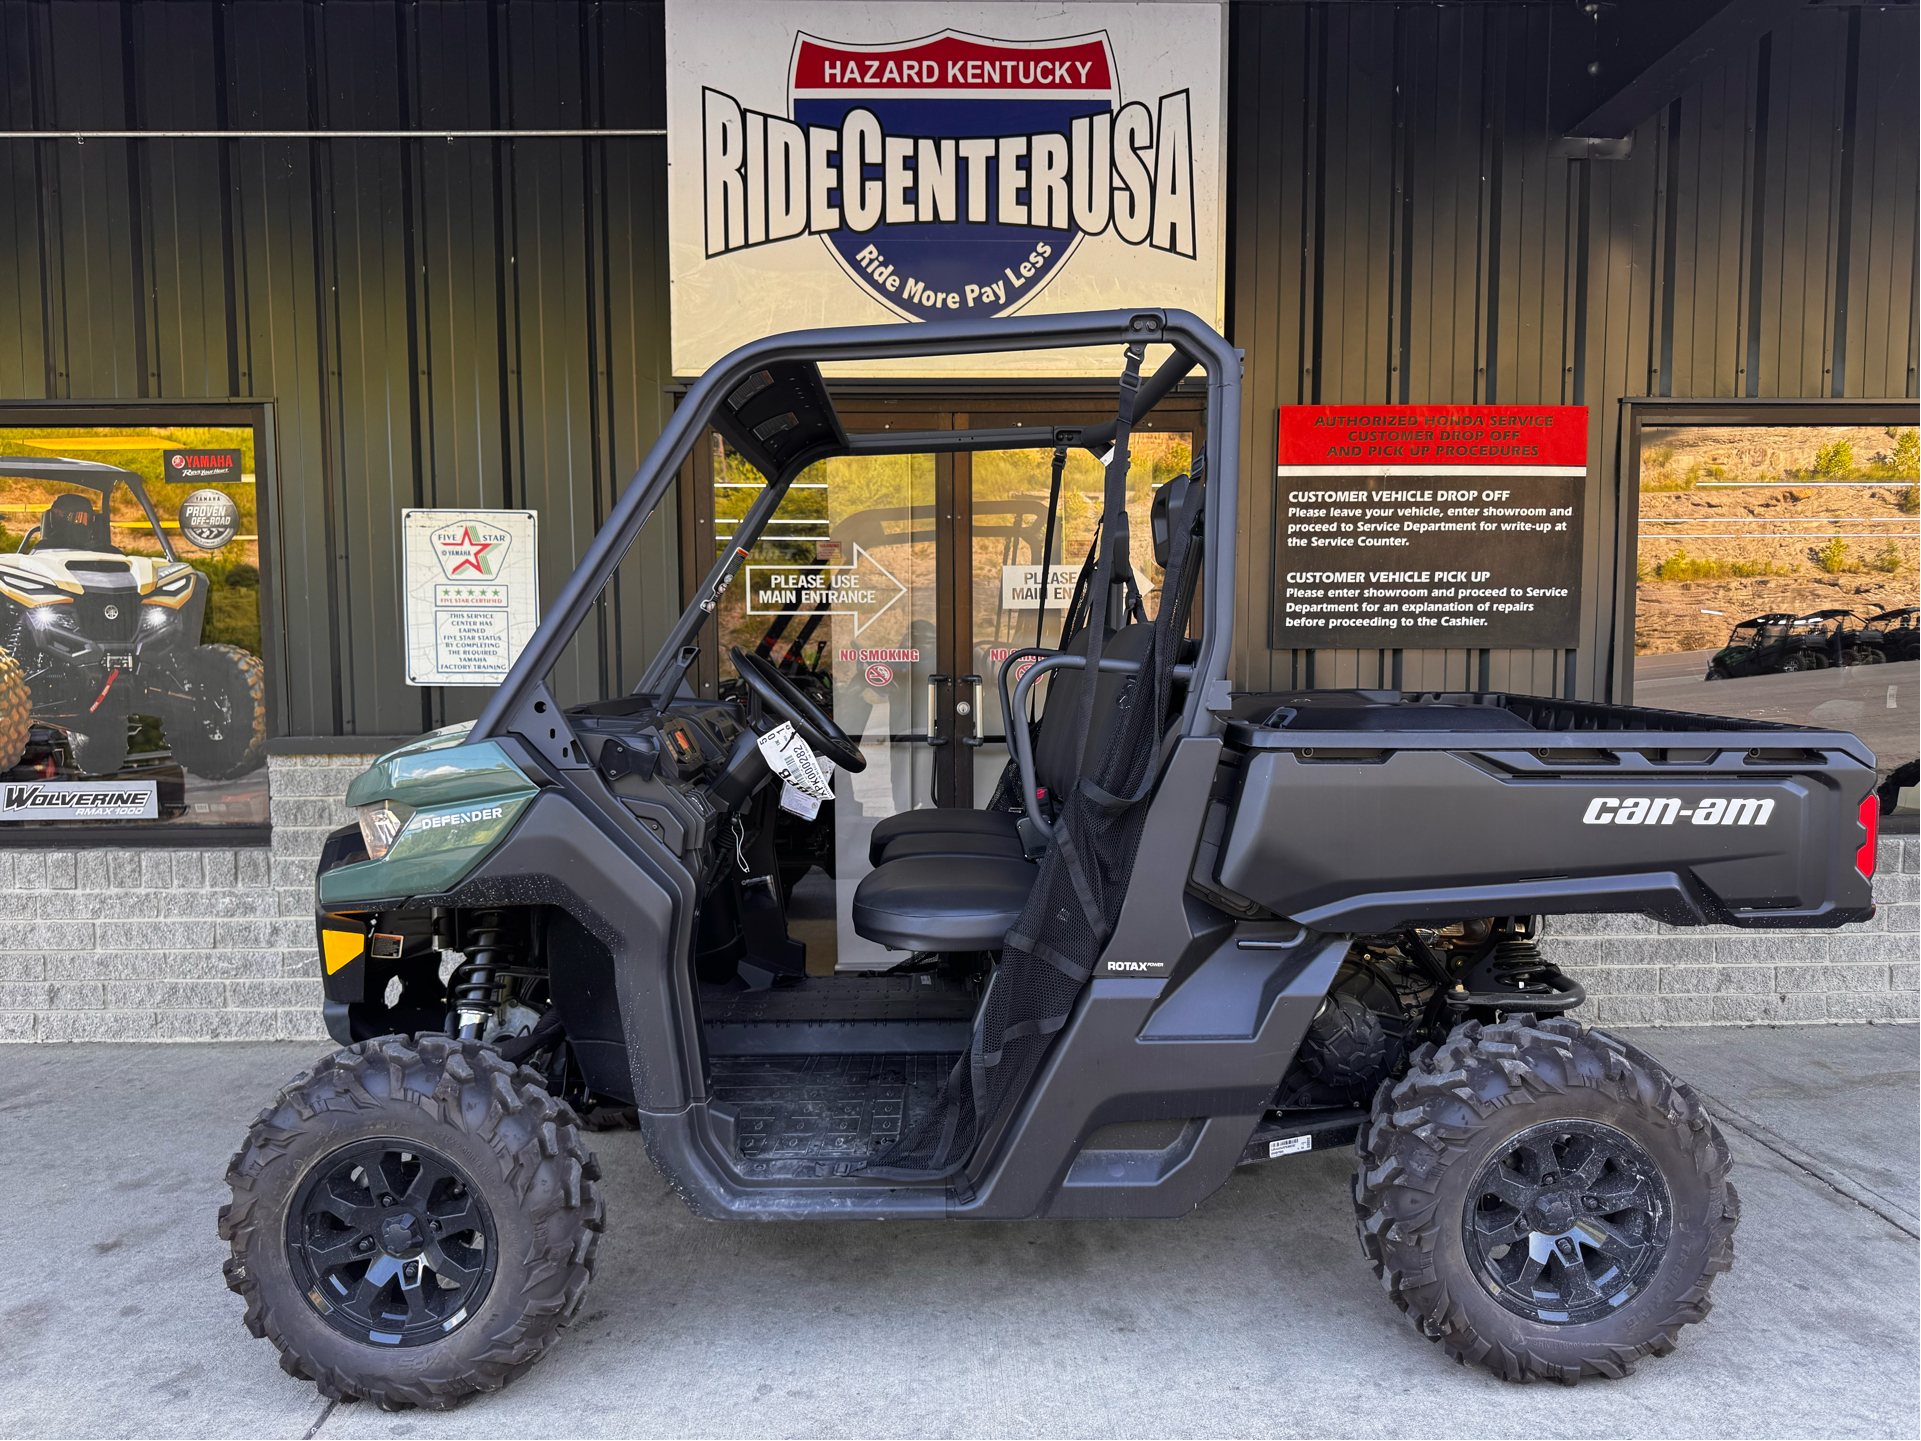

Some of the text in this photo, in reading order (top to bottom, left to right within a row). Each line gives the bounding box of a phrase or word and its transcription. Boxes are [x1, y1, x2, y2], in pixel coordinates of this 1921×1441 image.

[824, 60, 1093, 85] HAZARD KENTUCKY
[855, 240, 1053, 309] Ride More Pay Less
[1314, 416, 1553, 426] AUTHORIZED HONDA SERVICE
[1348, 431, 1520, 441] CUSTOMER DROP OFF
[1327, 446, 1538, 456] AND PICK UP PROCEDURES
[185, 455, 233, 468] YAMAHA
[1289, 491, 1510, 502] CUSTOMER VEHICLE DROP OFF
[186, 506, 226, 517] PROVEN
[1289, 507, 1572, 519] Please leave your vehicle, enter showroom and
[191, 517, 231, 526] OFF-ROAD
[1288, 521, 1567, 534] proceed to Service Department for write-up at
[1287, 537, 1409, 546] the Service Counter.
[770, 575, 860, 588] PLEASE USE
[1024, 572, 1078, 584] PLASE
[1287, 572, 1490, 583] CUSTOMER VEHICLE PICK UP
[759, 590, 876, 604] MAIN ENTRANCE
[1287, 587, 1568, 599] Please enter showroom and proceed to Service
[1286, 603, 1358, 614] Department
[1362, 602, 1380, 611] for
[1402, 602, 1473, 614] explanation
[1477, 602, 1490, 611] of
[1493, 602, 1534, 613] repairs
[1286, 617, 1487, 628] before proceeding to the Cashier.
[840, 648, 920, 663] NO SMOKING
[990, 649, 1007, 661] NO
[1582, 797, 1775, 826] can-am
[421, 807, 503, 830] DEFENDER
[1107, 961, 1148, 971] ROTAX
